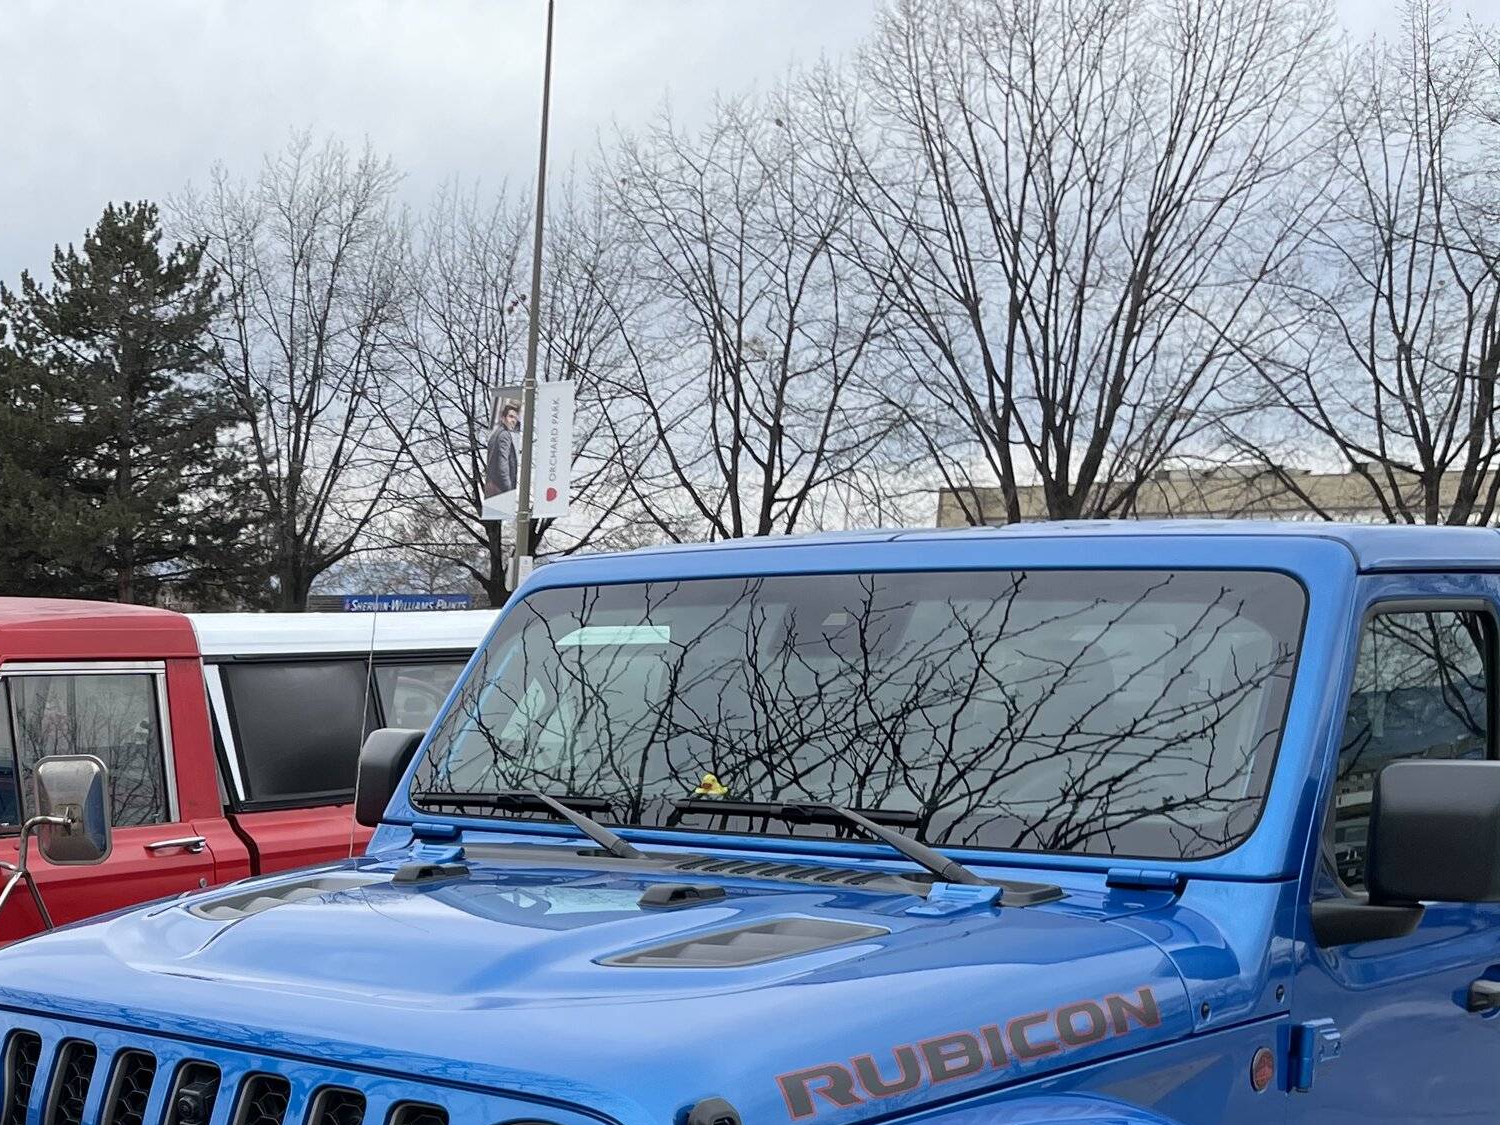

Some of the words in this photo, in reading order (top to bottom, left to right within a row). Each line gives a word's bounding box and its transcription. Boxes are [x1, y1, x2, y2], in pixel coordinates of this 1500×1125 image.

[550, 397, 561, 425] PARK
[548, 428, 560, 482] ORCHARD
[435, 599, 467, 610] PAINTS
[775, 986, 1162, 1121] RUBICON
